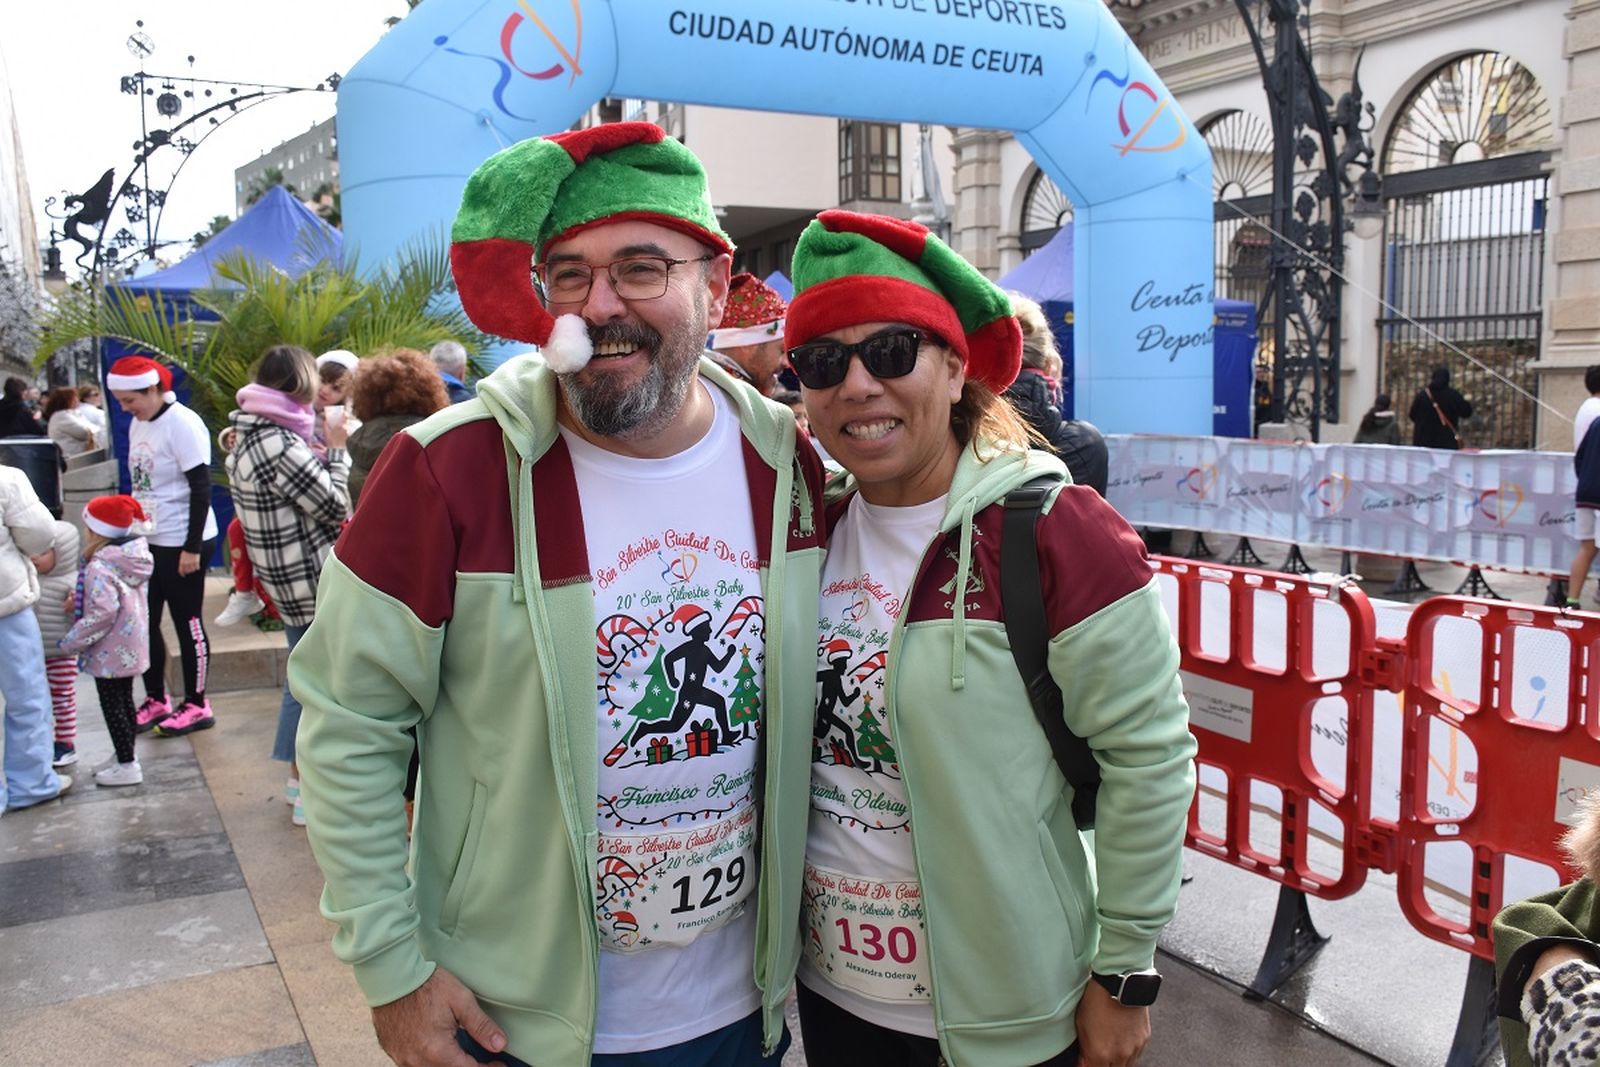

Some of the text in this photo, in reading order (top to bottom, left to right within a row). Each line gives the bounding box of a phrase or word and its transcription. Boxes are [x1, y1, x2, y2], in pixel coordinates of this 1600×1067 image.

[935, 0, 1066, 30] DEPORTES
[668, 10, 1044, 76] CIUDAD AUTÓNOMA DE CEUTA
[1131, 279, 1205, 312] Ceuta
[597, 567, 618, 590] San
[619, 536, 661, 572] Silvestre
[665, 529, 710, 552] Ciudad
[714, 540, 736, 562] De
[640, 590, 662, 607] San
[666, 584, 710, 605] Silvestre
[714, 579, 744, 597] Baby
[615, 785, 700, 809] Francisco
[851, 788, 907, 817] Oderay
[609, 838, 632, 855] San
[636, 837, 682, 856] Silvestre
[670, 855, 746, 915] 129
[839, 877, 870, 900] Ciudad
[872, 883, 891, 899] De
[841, 898, 857, 911] San
[835, 917, 917, 964] 130
[845, 961, 917, 981] Alexandra Oderay
